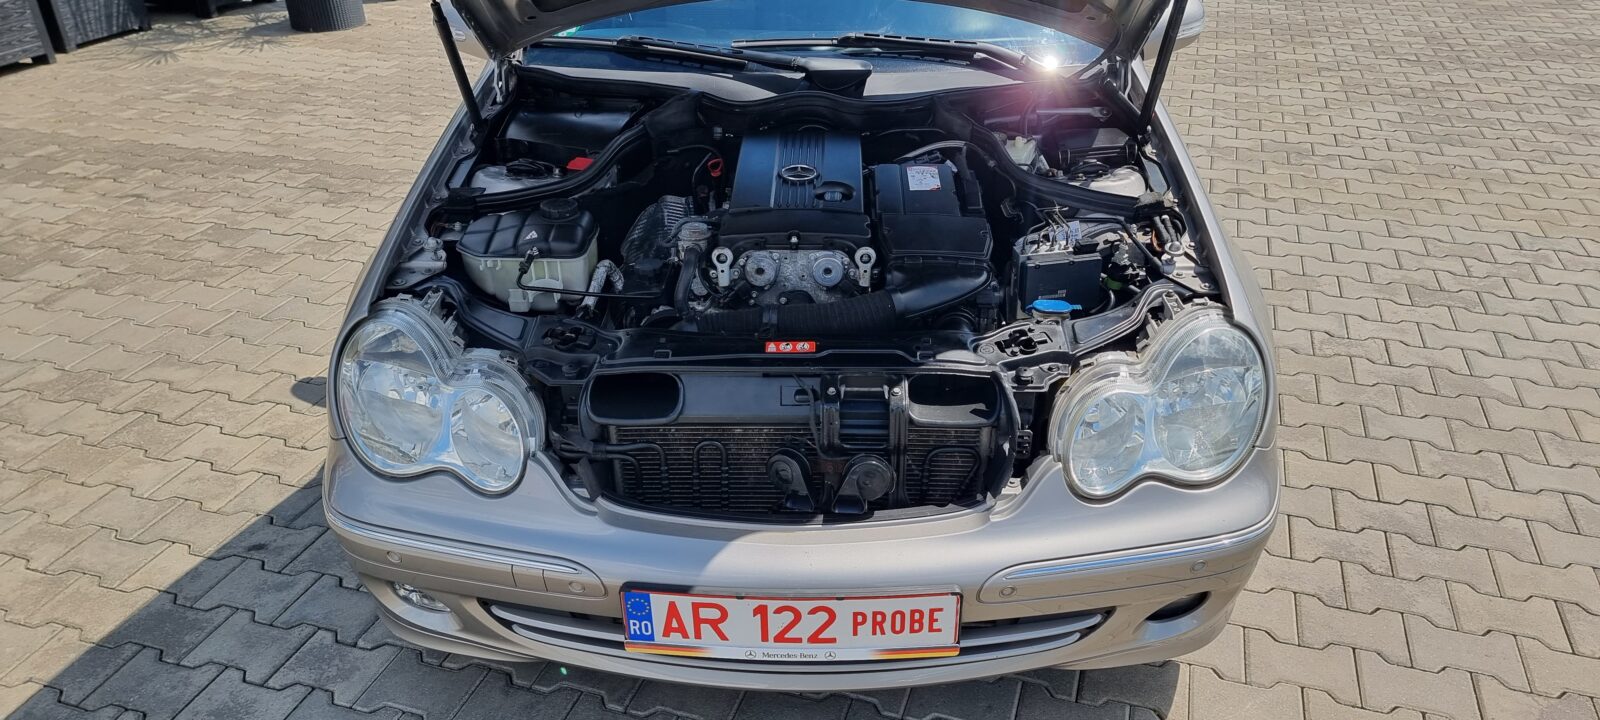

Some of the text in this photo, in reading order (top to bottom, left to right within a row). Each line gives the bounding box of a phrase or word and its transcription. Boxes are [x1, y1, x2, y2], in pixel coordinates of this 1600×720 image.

[629, 619, 652, 635] RO
[662, 601, 944, 644] AR 122 PROBE
